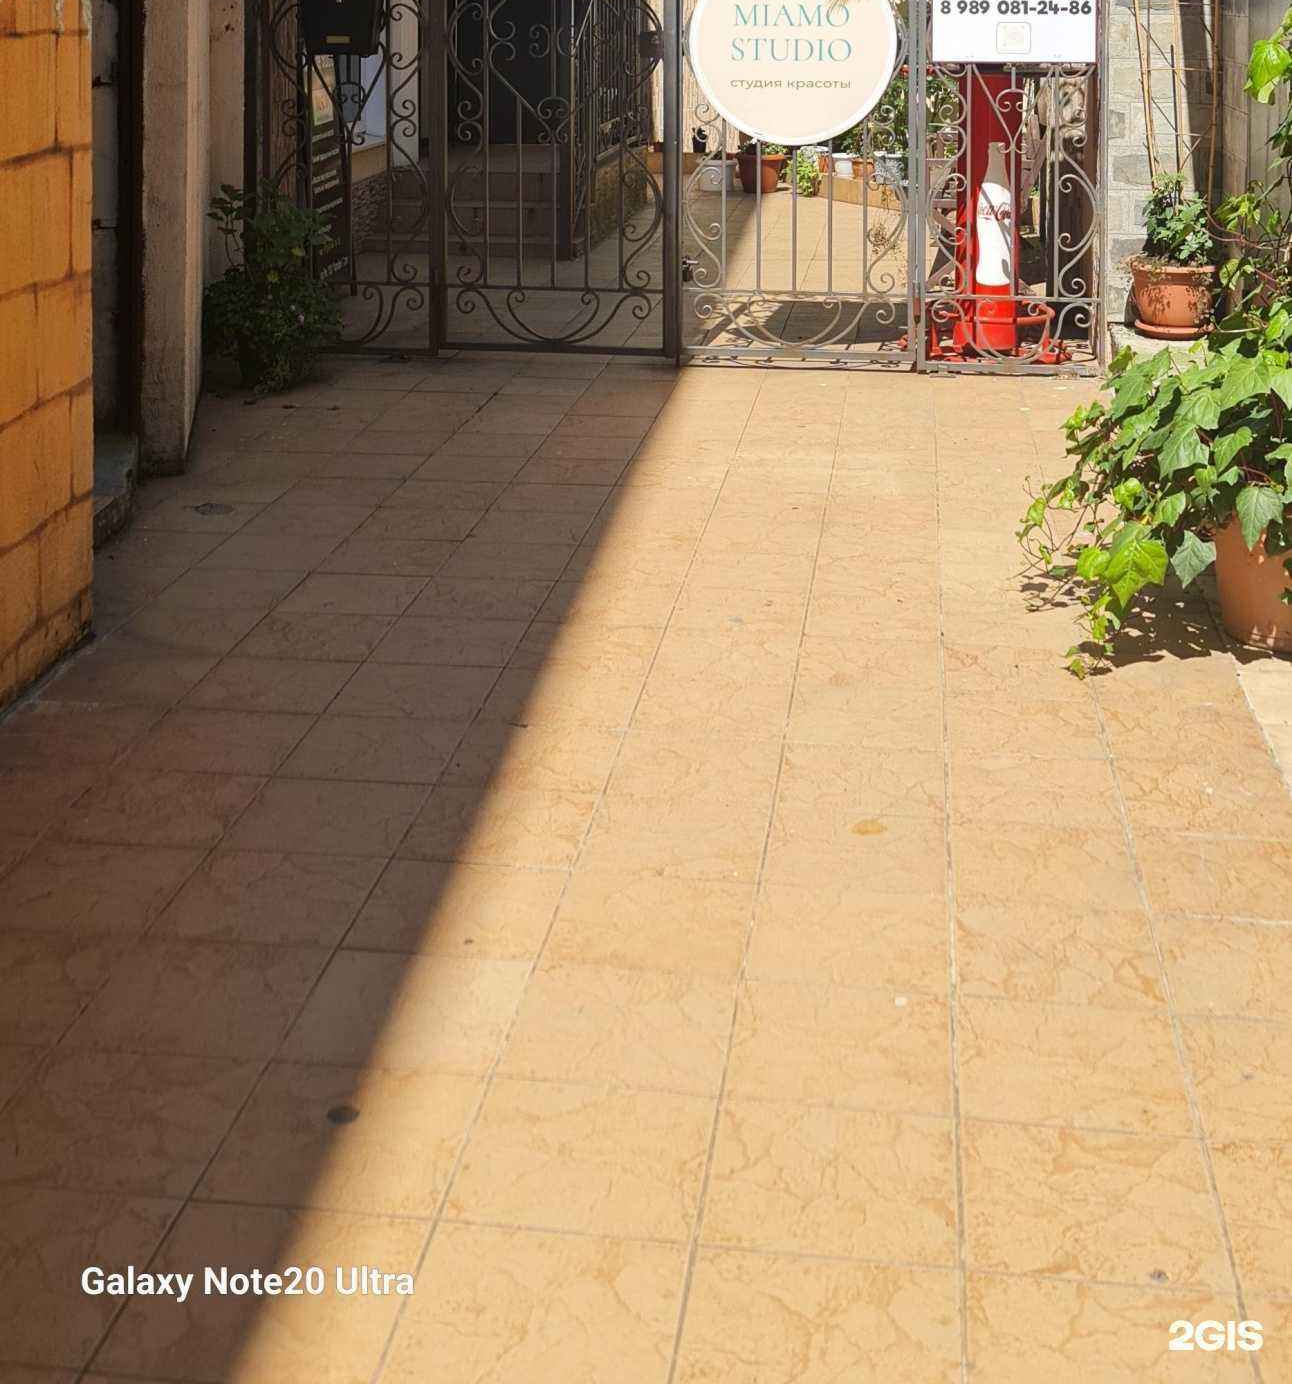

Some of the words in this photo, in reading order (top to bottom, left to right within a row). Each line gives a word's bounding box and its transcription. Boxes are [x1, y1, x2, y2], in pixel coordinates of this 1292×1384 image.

[734, 3, 849, 27] MIAMO
[940, 0, 951, 15] 8
[957, 0, 990, 15] 989
[997, 0, 1092, 15] 081-24-86
[731, 38, 852, 62] STUDIO
[730, 79, 782, 90] студия
[787, 79, 851, 90] красоты
